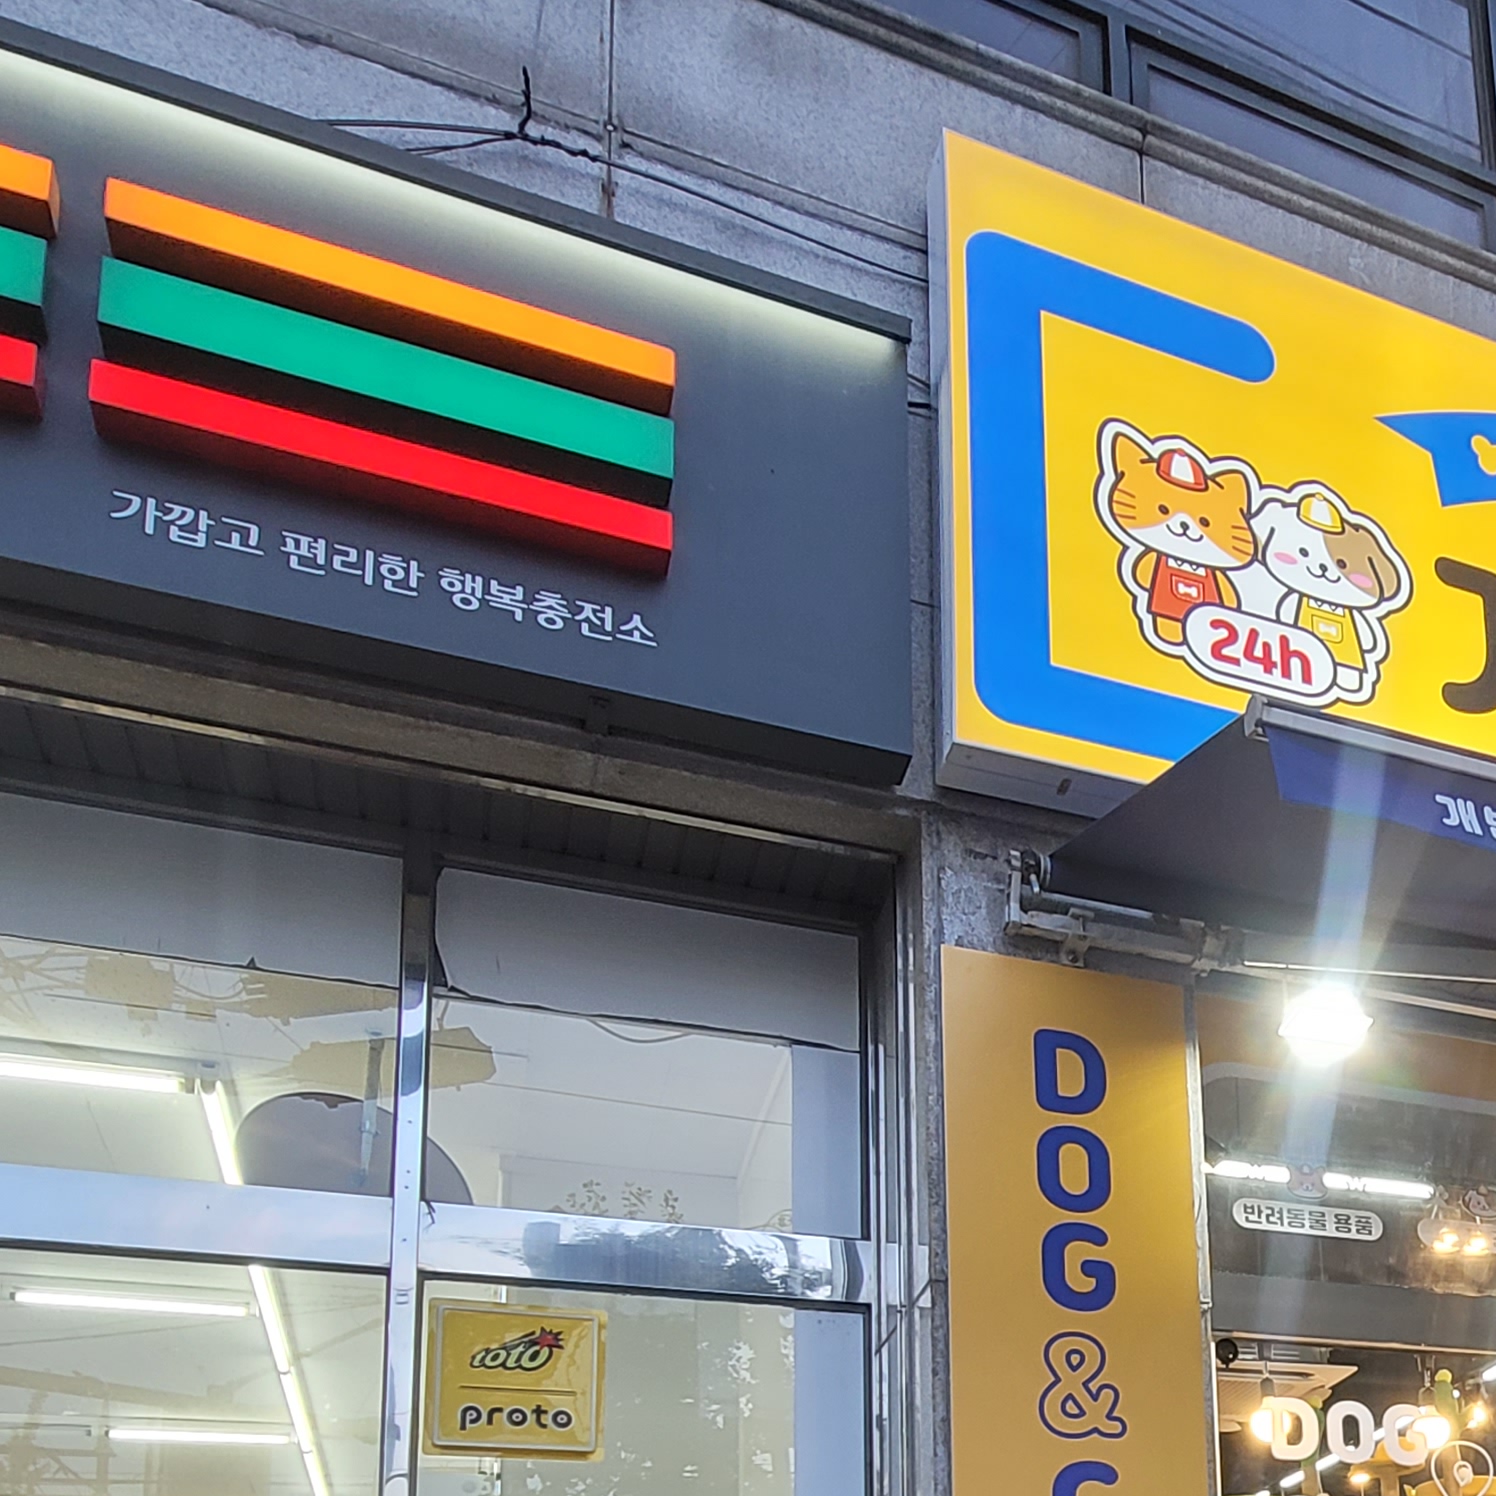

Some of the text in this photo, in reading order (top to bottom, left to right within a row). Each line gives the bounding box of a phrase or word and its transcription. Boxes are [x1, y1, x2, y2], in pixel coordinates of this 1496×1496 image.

[109, 489, 658, 647] 가깝고 편리한 행복충전소
[1210, 618, 1313, 686] 24h
[1033, 1028, 1117, 1312] DOG
[1243, 1202, 1373, 1236] 반려동물 용품
[459, 1402, 574, 1431] proto
[1038, 1331, 1127, 1438] &
[1263, 1397, 1430, 1466] DOG
